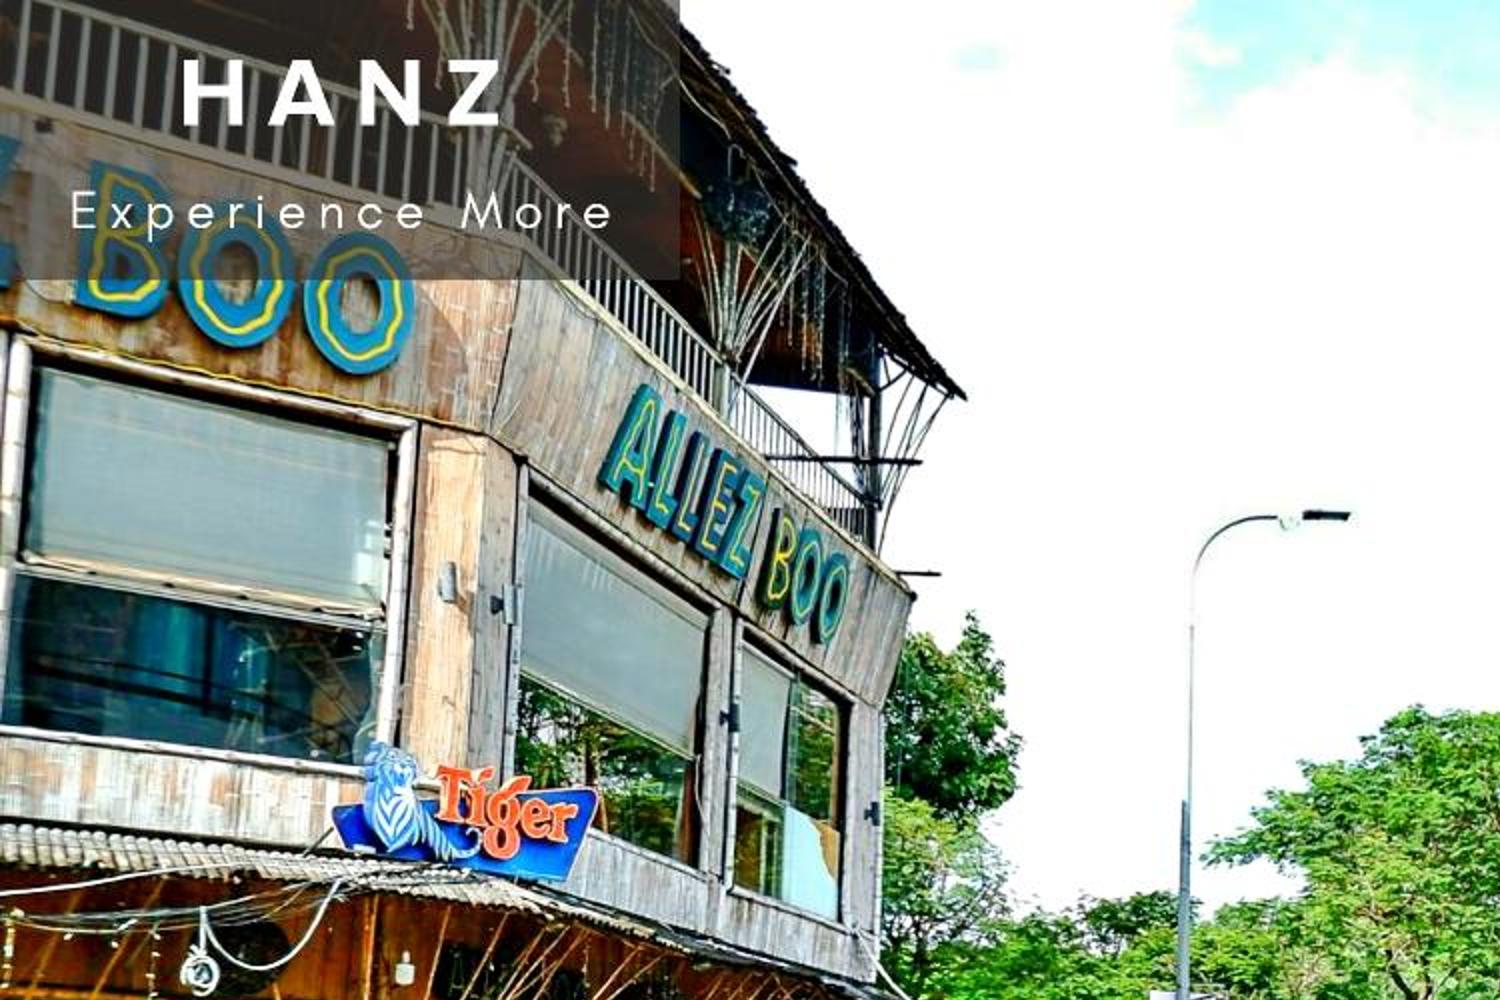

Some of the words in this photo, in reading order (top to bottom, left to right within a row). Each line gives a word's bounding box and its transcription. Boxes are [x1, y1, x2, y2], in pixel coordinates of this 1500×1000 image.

[73, 159, 416, 377] BOO
[597, 383, 768, 580] ALLEZ
[760, 507, 850, 646] BOO
[435, 764, 579, 861] Tiger
